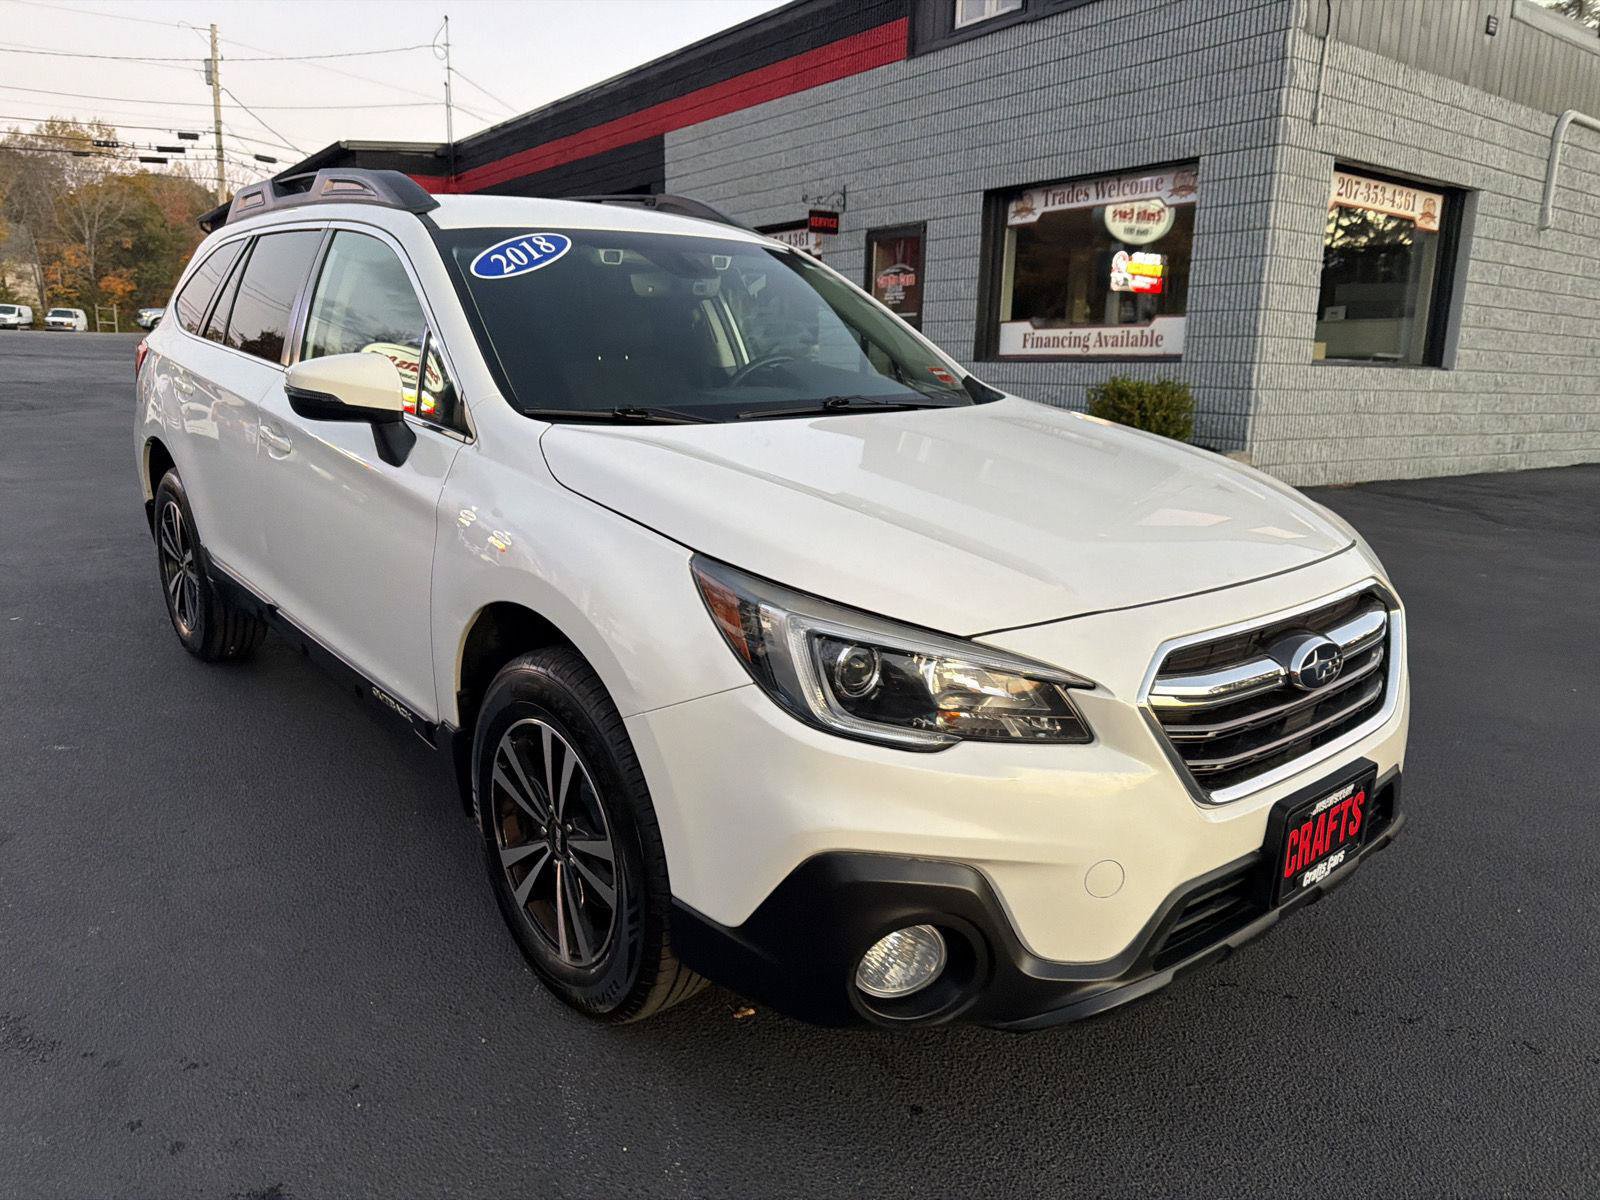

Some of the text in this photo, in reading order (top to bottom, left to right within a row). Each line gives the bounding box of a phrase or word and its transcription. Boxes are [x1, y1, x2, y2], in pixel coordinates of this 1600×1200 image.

[1041, 175, 1164, 208] Trades Welcome
[1336, 176, 1418, 213] 207-353-4361
[811, 216, 838, 229] SERVICE
[490, 236, 556, 274] 2018
[1022, 330, 1164, 353] Financing Available
[1284, 791, 1366, 878] CRAFTS
